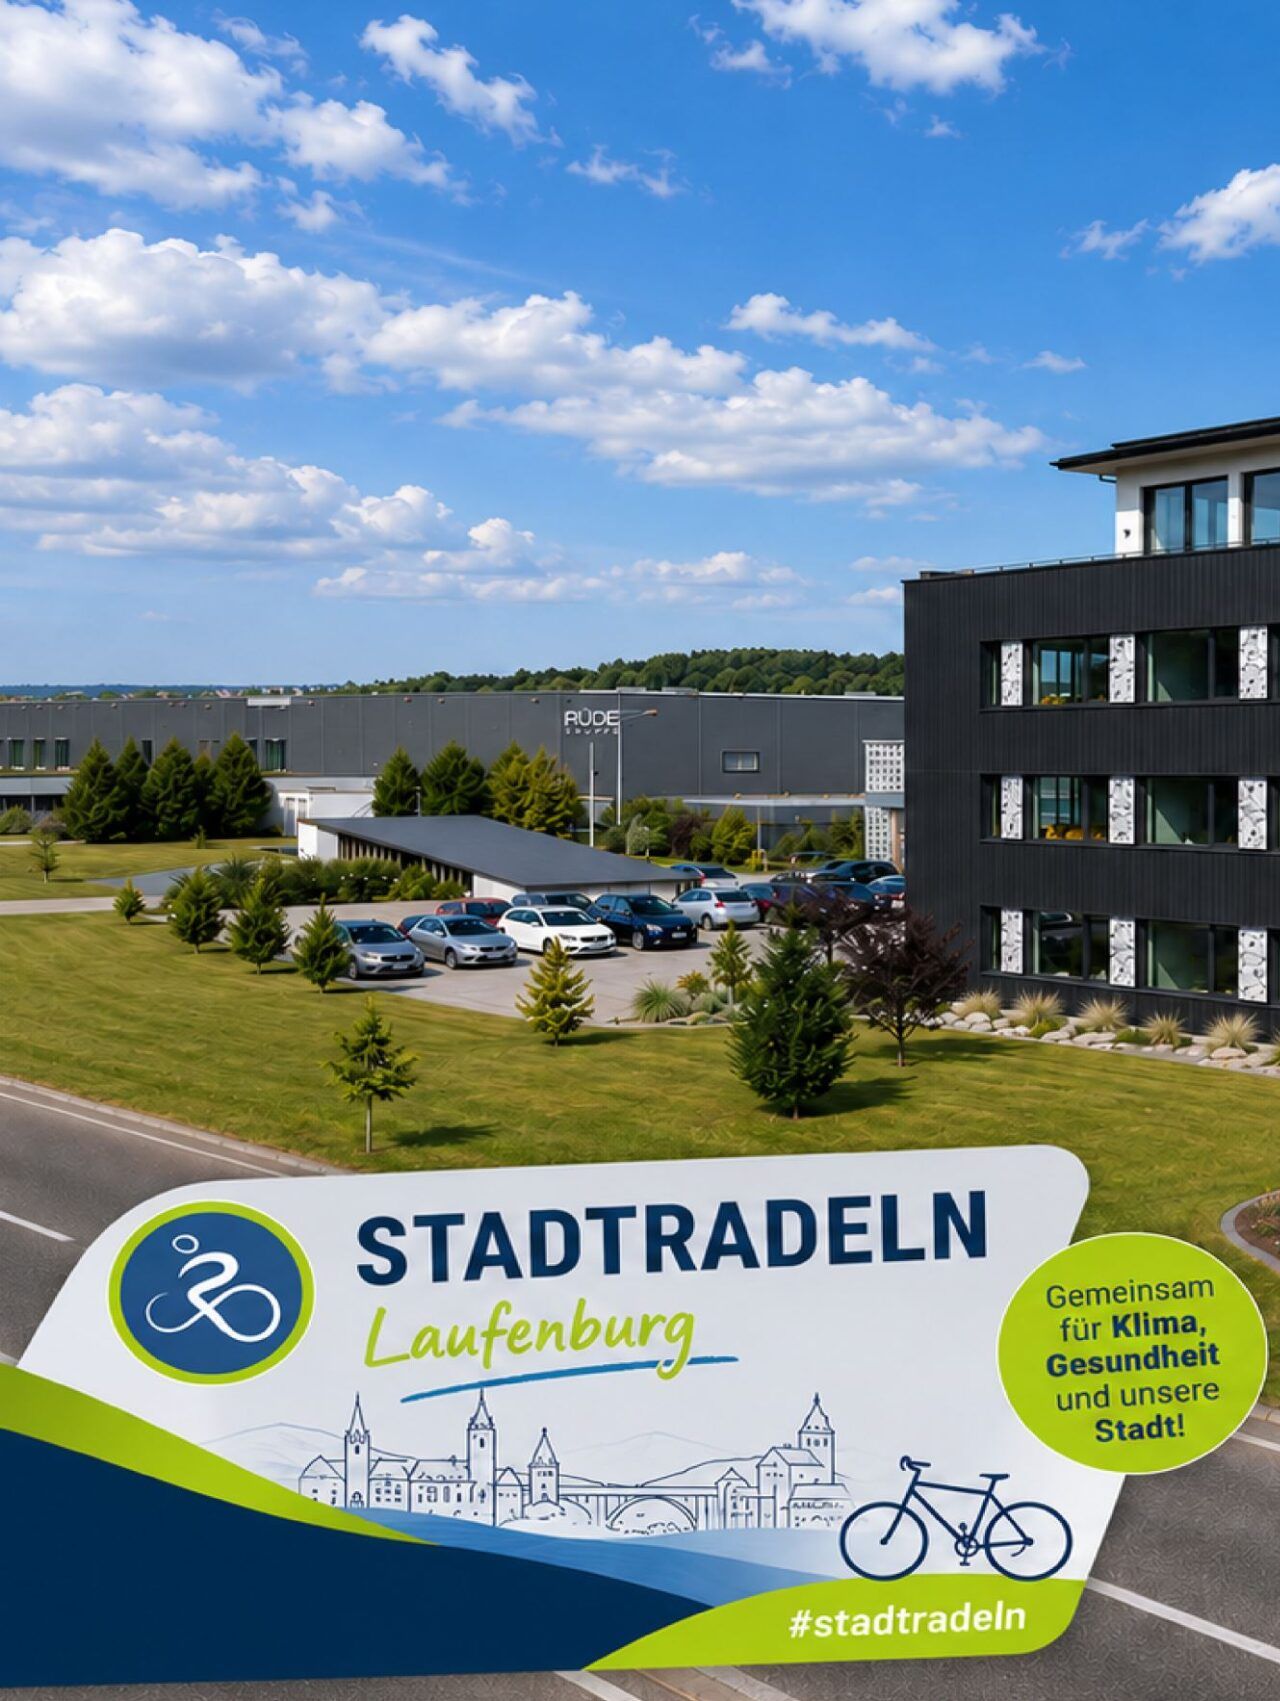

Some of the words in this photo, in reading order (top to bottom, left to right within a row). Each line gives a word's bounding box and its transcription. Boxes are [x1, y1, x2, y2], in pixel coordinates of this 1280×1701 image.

[356, 1190, 987, 1286] STADTRADELN
[1046, 1278, 1214, 1309] Gemeinsam
[364, 1298, 695, 1381] Laufenburg
[1060, 1316, 1102, 1342] für
[1111, 1311, 1207, 1339] Klima,
[1046, 1341, 1221, 1378] Gesundheit
[1056, 1383, 1111, 1411] und
[1120, 1382, 1220, 1407] unsere
[1094, 1413, 1185, 1443] Stadt!
[788, 1600, 1026, 1639] #stadtradeln
